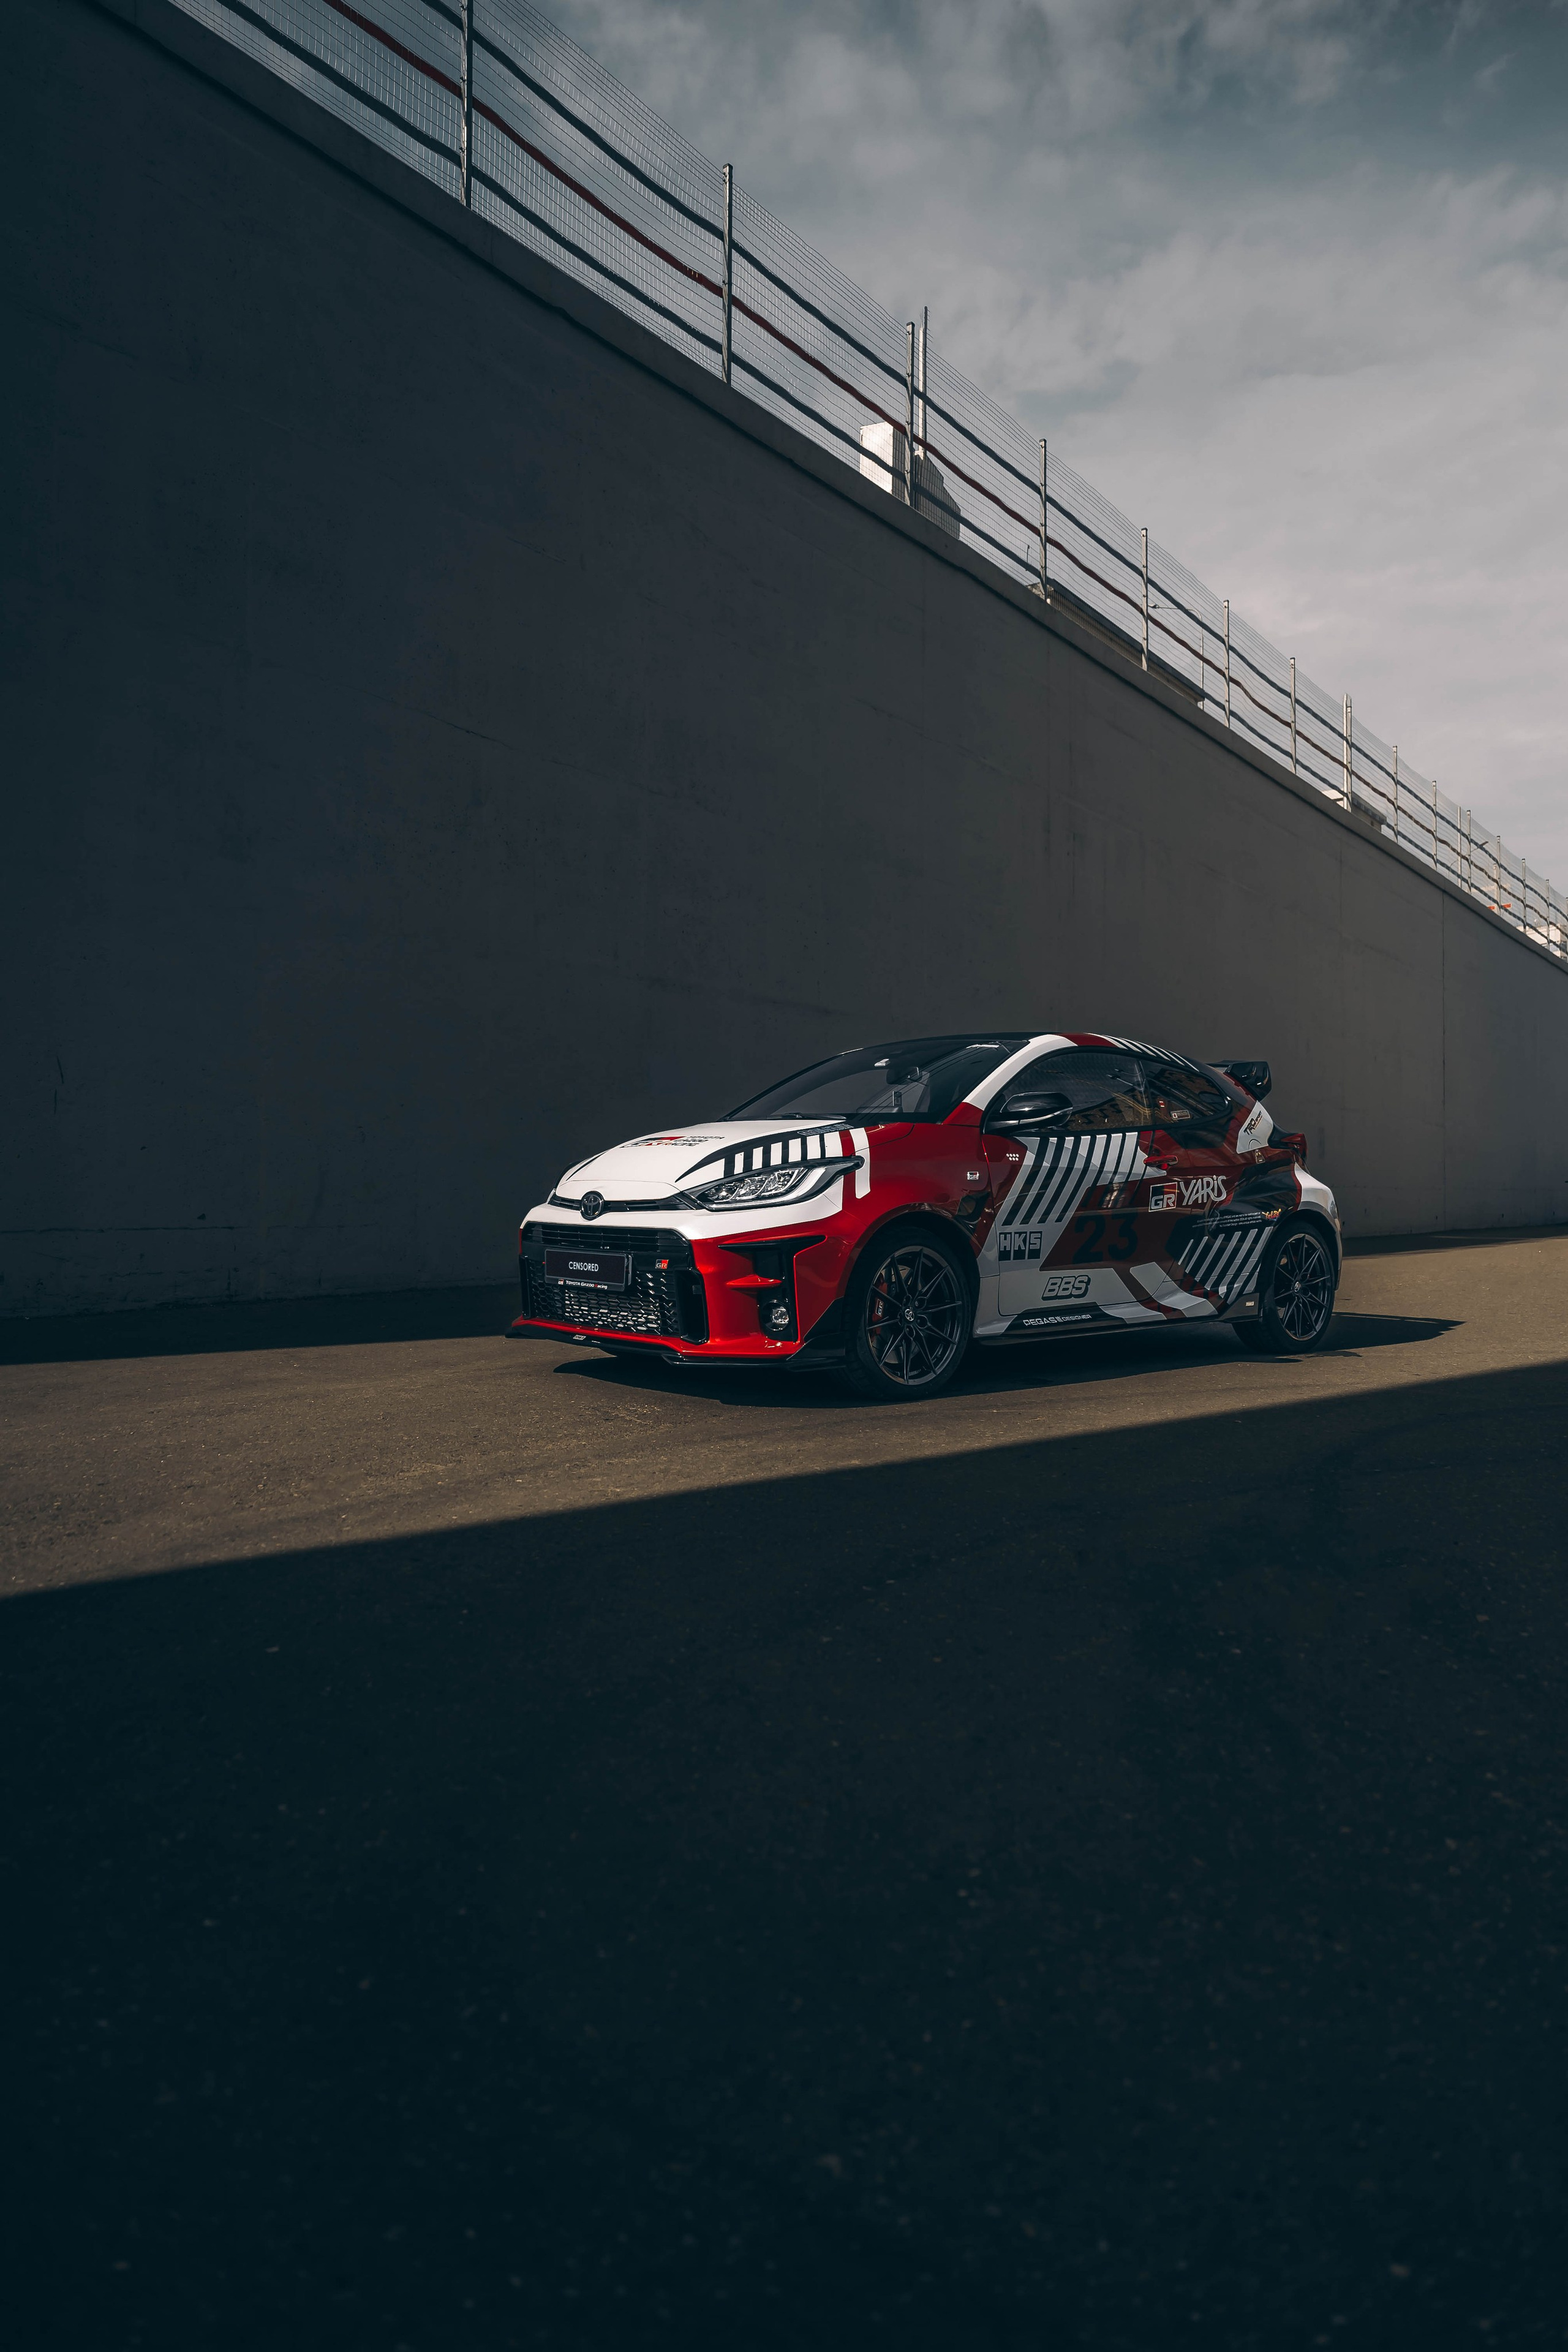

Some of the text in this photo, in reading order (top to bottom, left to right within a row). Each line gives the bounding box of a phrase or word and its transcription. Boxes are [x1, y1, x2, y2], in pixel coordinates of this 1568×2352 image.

[1243, 1118, 1256, 1135] TRD
[1000, 1232, 1041, 1251] HKS
[1072, 1210, 1138, 1264] 23
[568, 1261, 599, 1272] CENSORED
[1041, 1274, 1091, 1301] BBS
[1022, 1317, 1058, 1327] PEGAS
